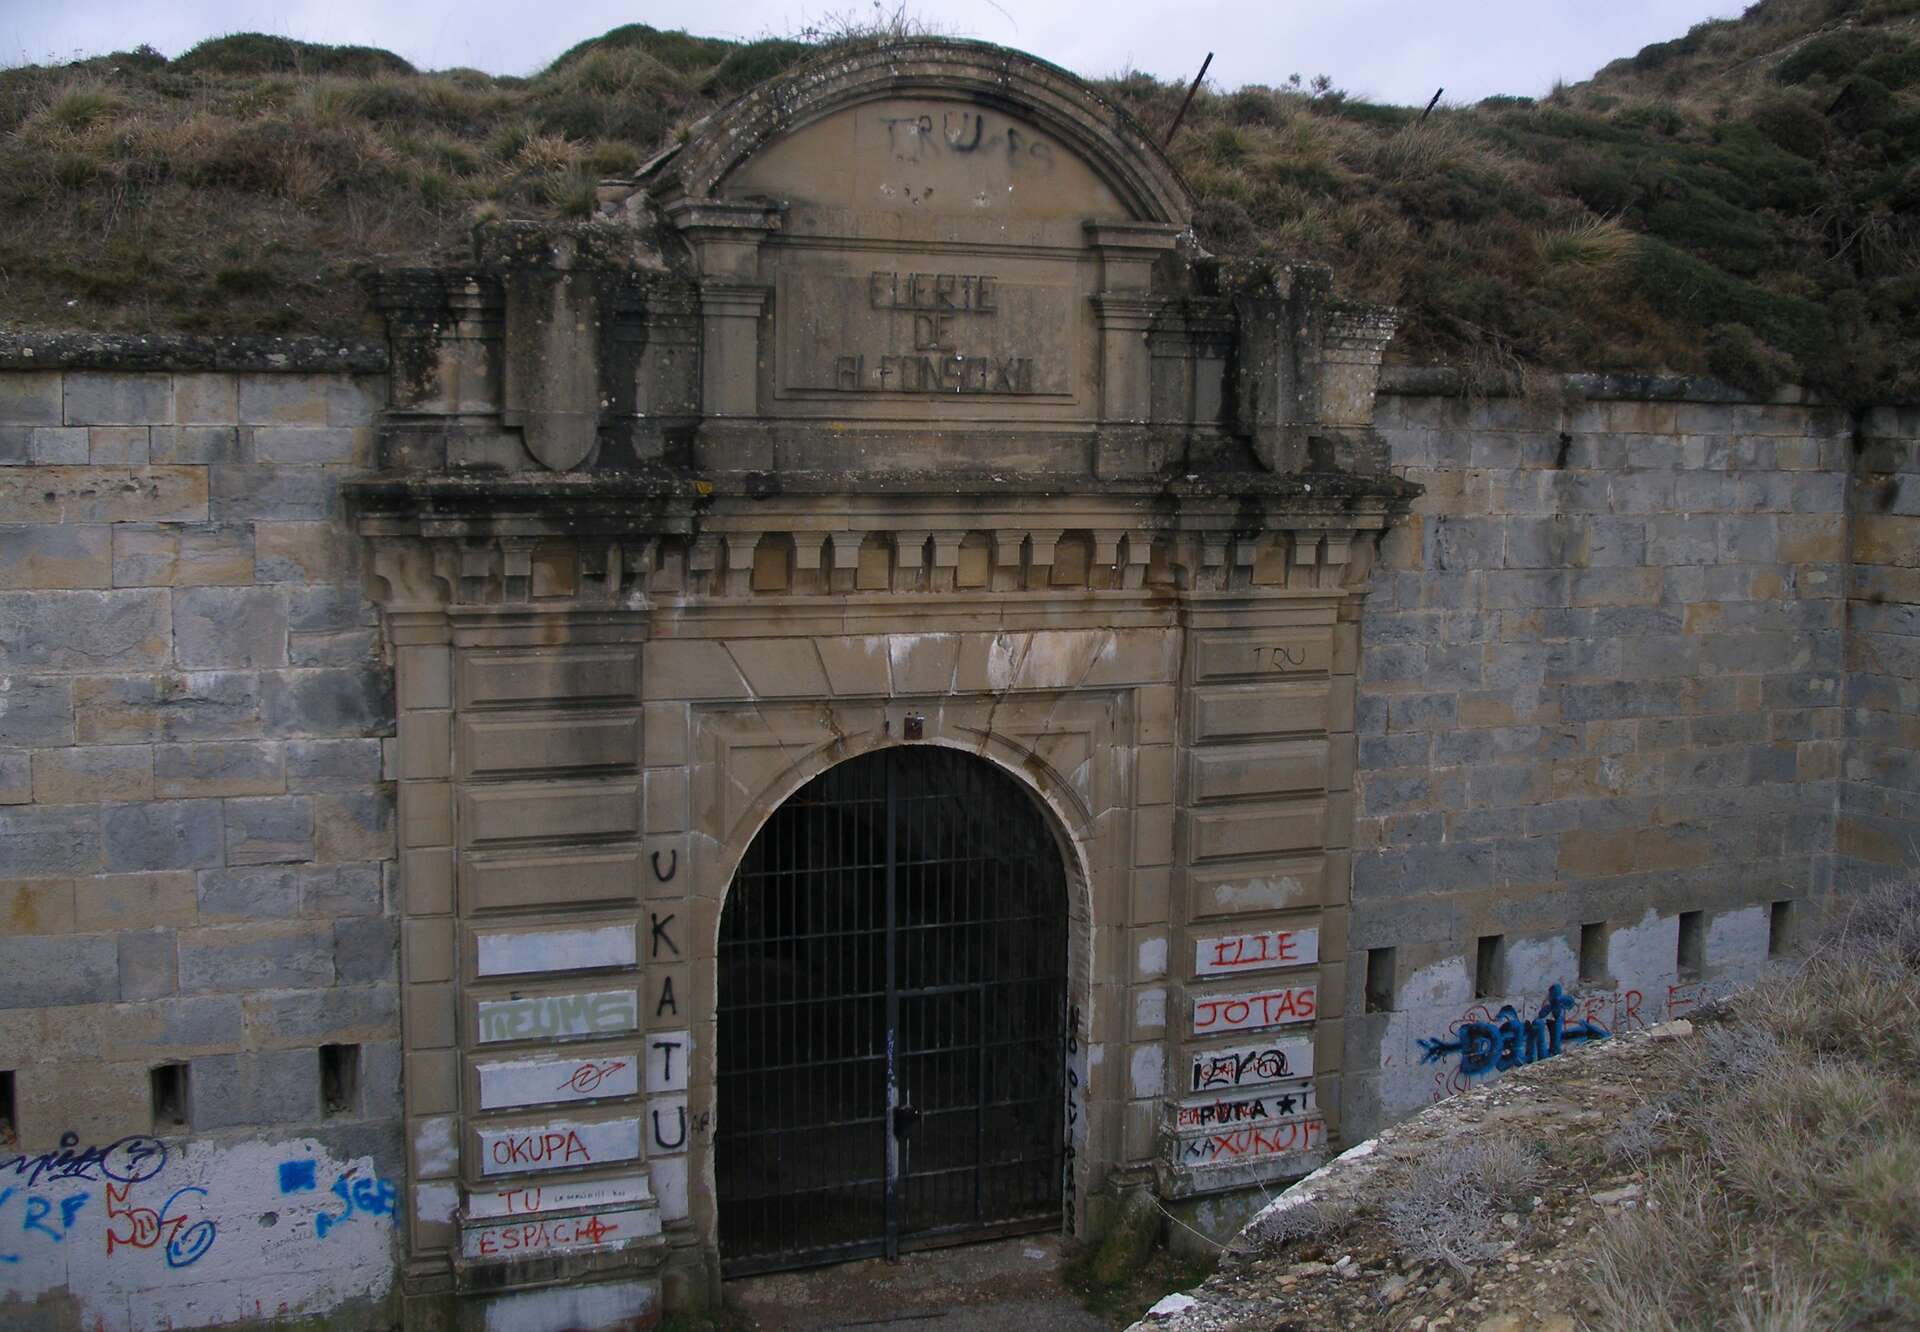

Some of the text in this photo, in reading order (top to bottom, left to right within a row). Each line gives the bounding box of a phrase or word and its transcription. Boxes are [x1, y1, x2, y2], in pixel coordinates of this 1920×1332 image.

[914, 313, 955, 352] DE
[1195, 990, 1315, 1027] JOTAS
[492, 1130, 592, 1166] OKUPA
[498, 1187, 541, 1214] TU
